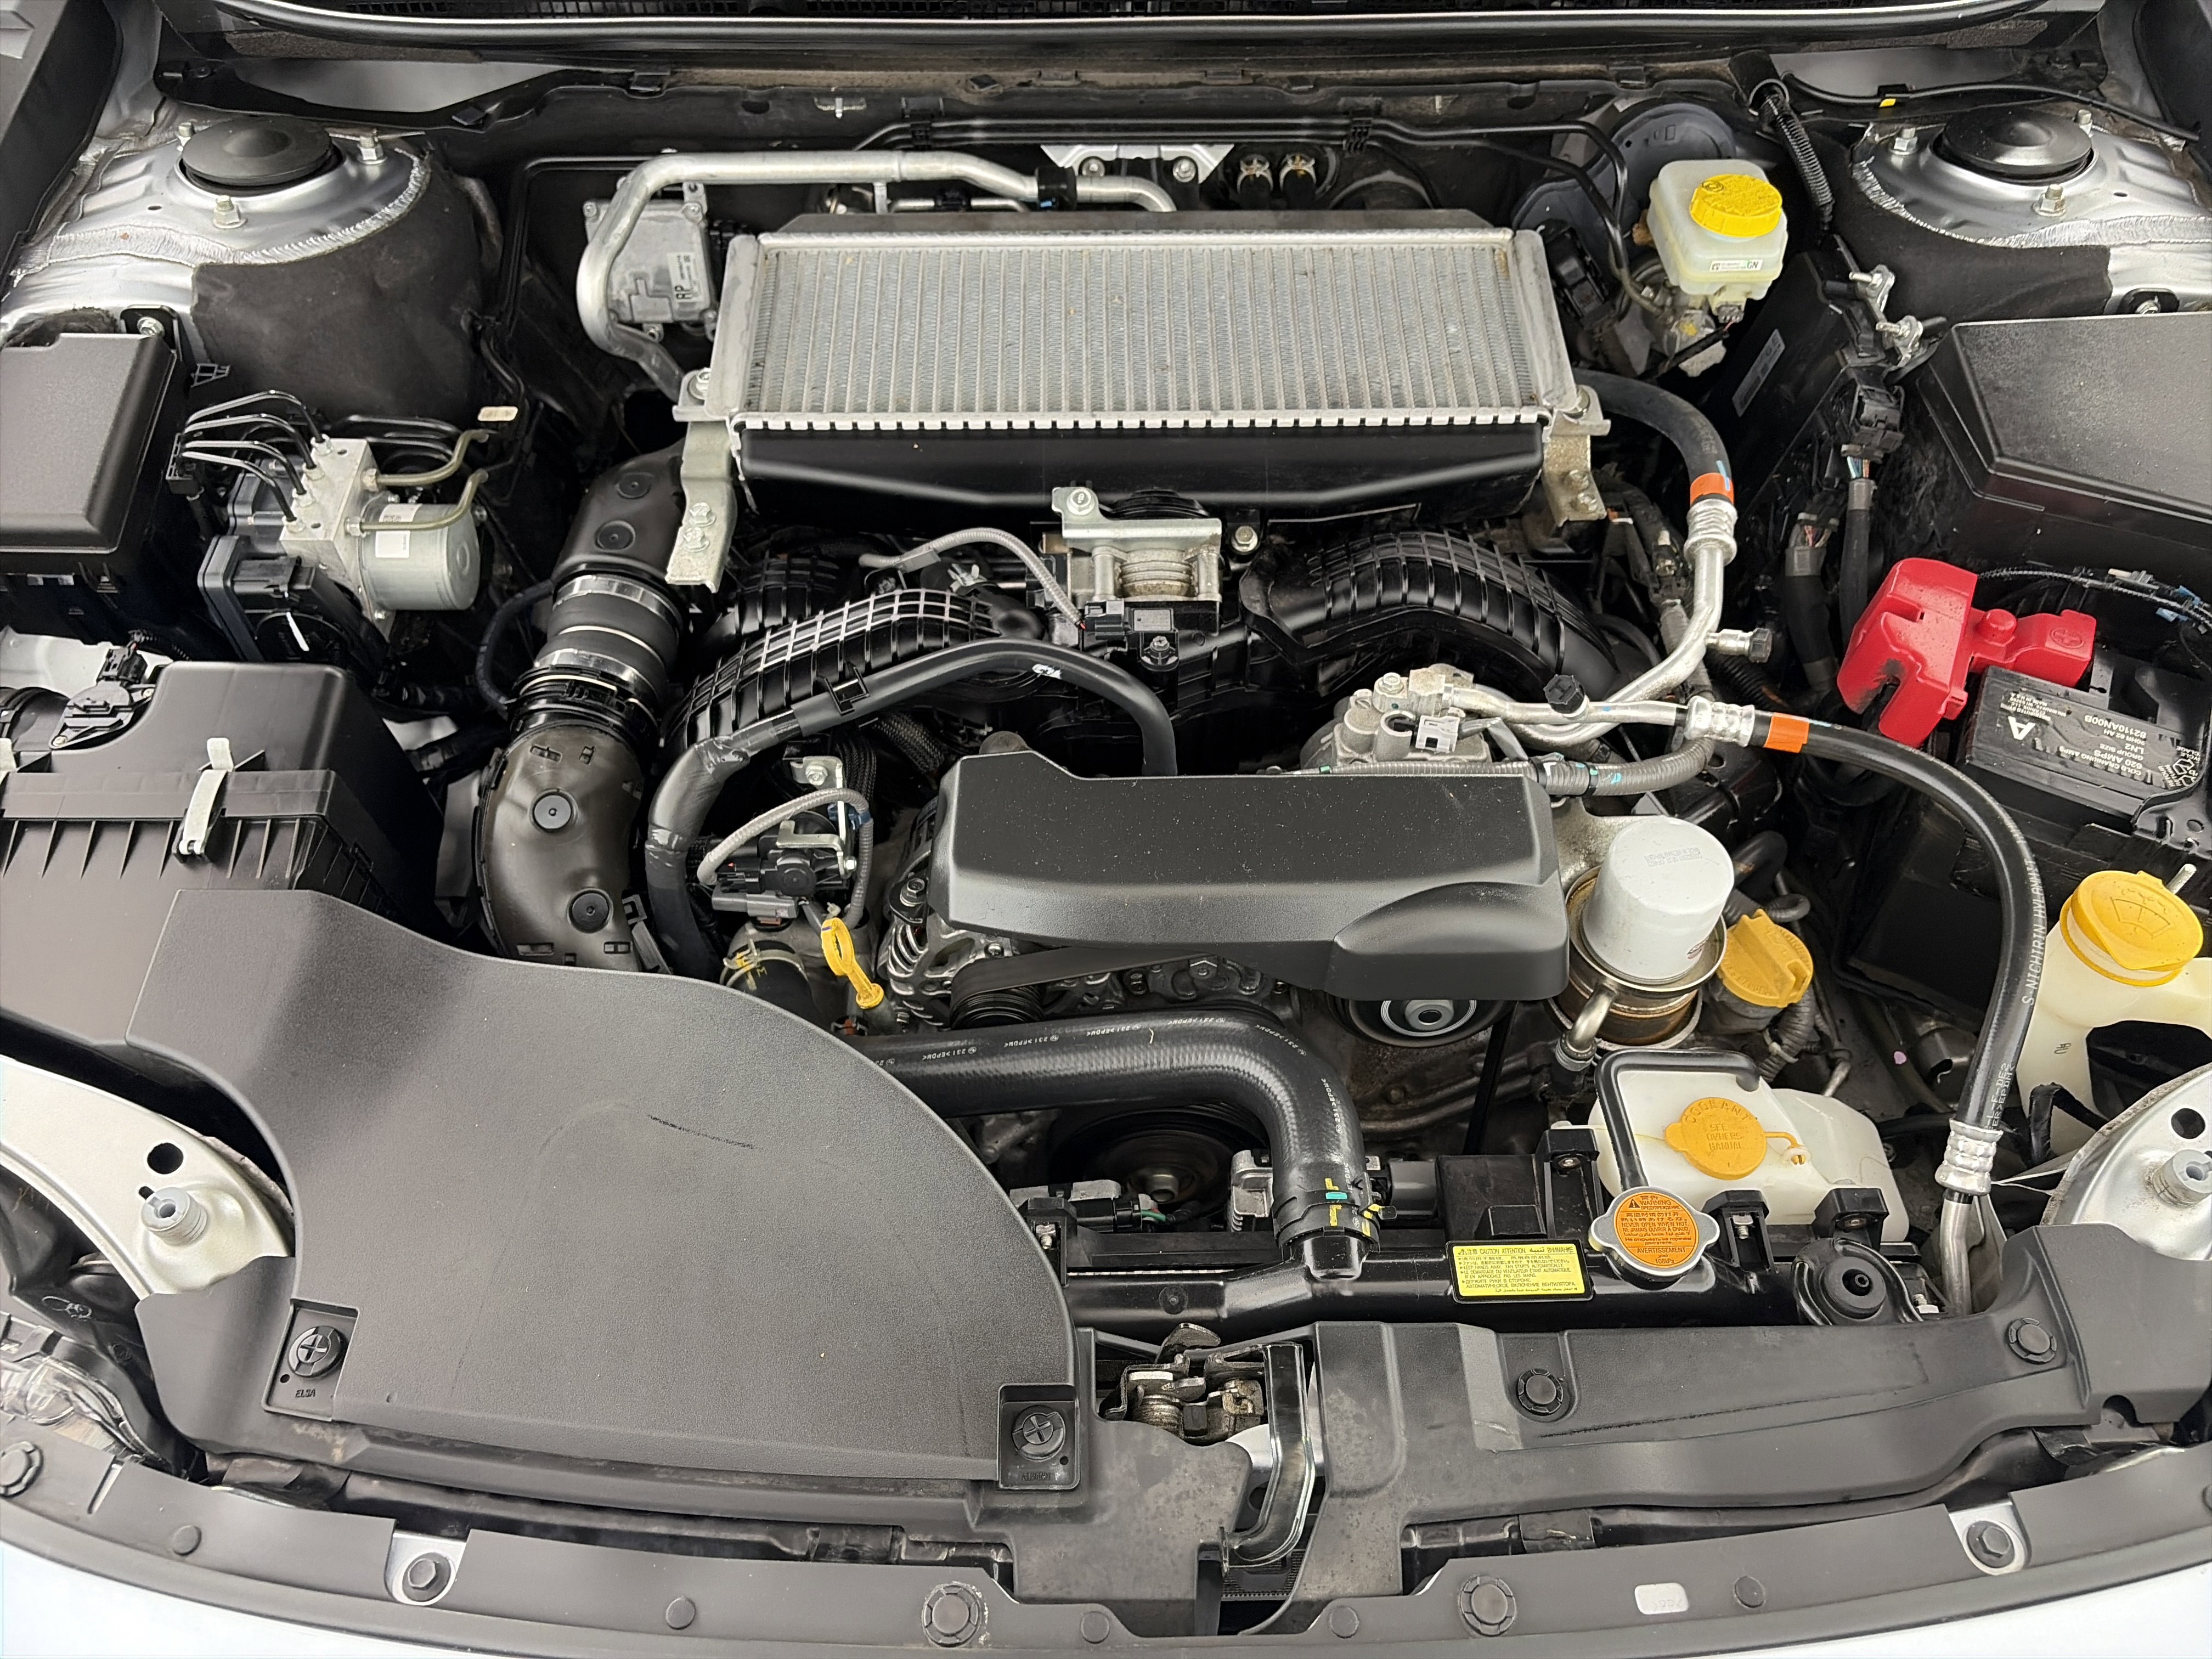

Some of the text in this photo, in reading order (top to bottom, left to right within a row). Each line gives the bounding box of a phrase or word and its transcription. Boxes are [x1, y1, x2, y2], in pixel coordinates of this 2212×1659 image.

[2100, 743, 2144, 761] GROUP SIZE
[2124, 743, 2145, 754] LN2
[2059, 745, 2142, 776] COLD CRANKING AMPS
[2094, 749, 2142, 770] 620 AMPS
[1685, 1099, 1752, 1124] COOLANT
[295, 1389, 316, 1398] ELSA
